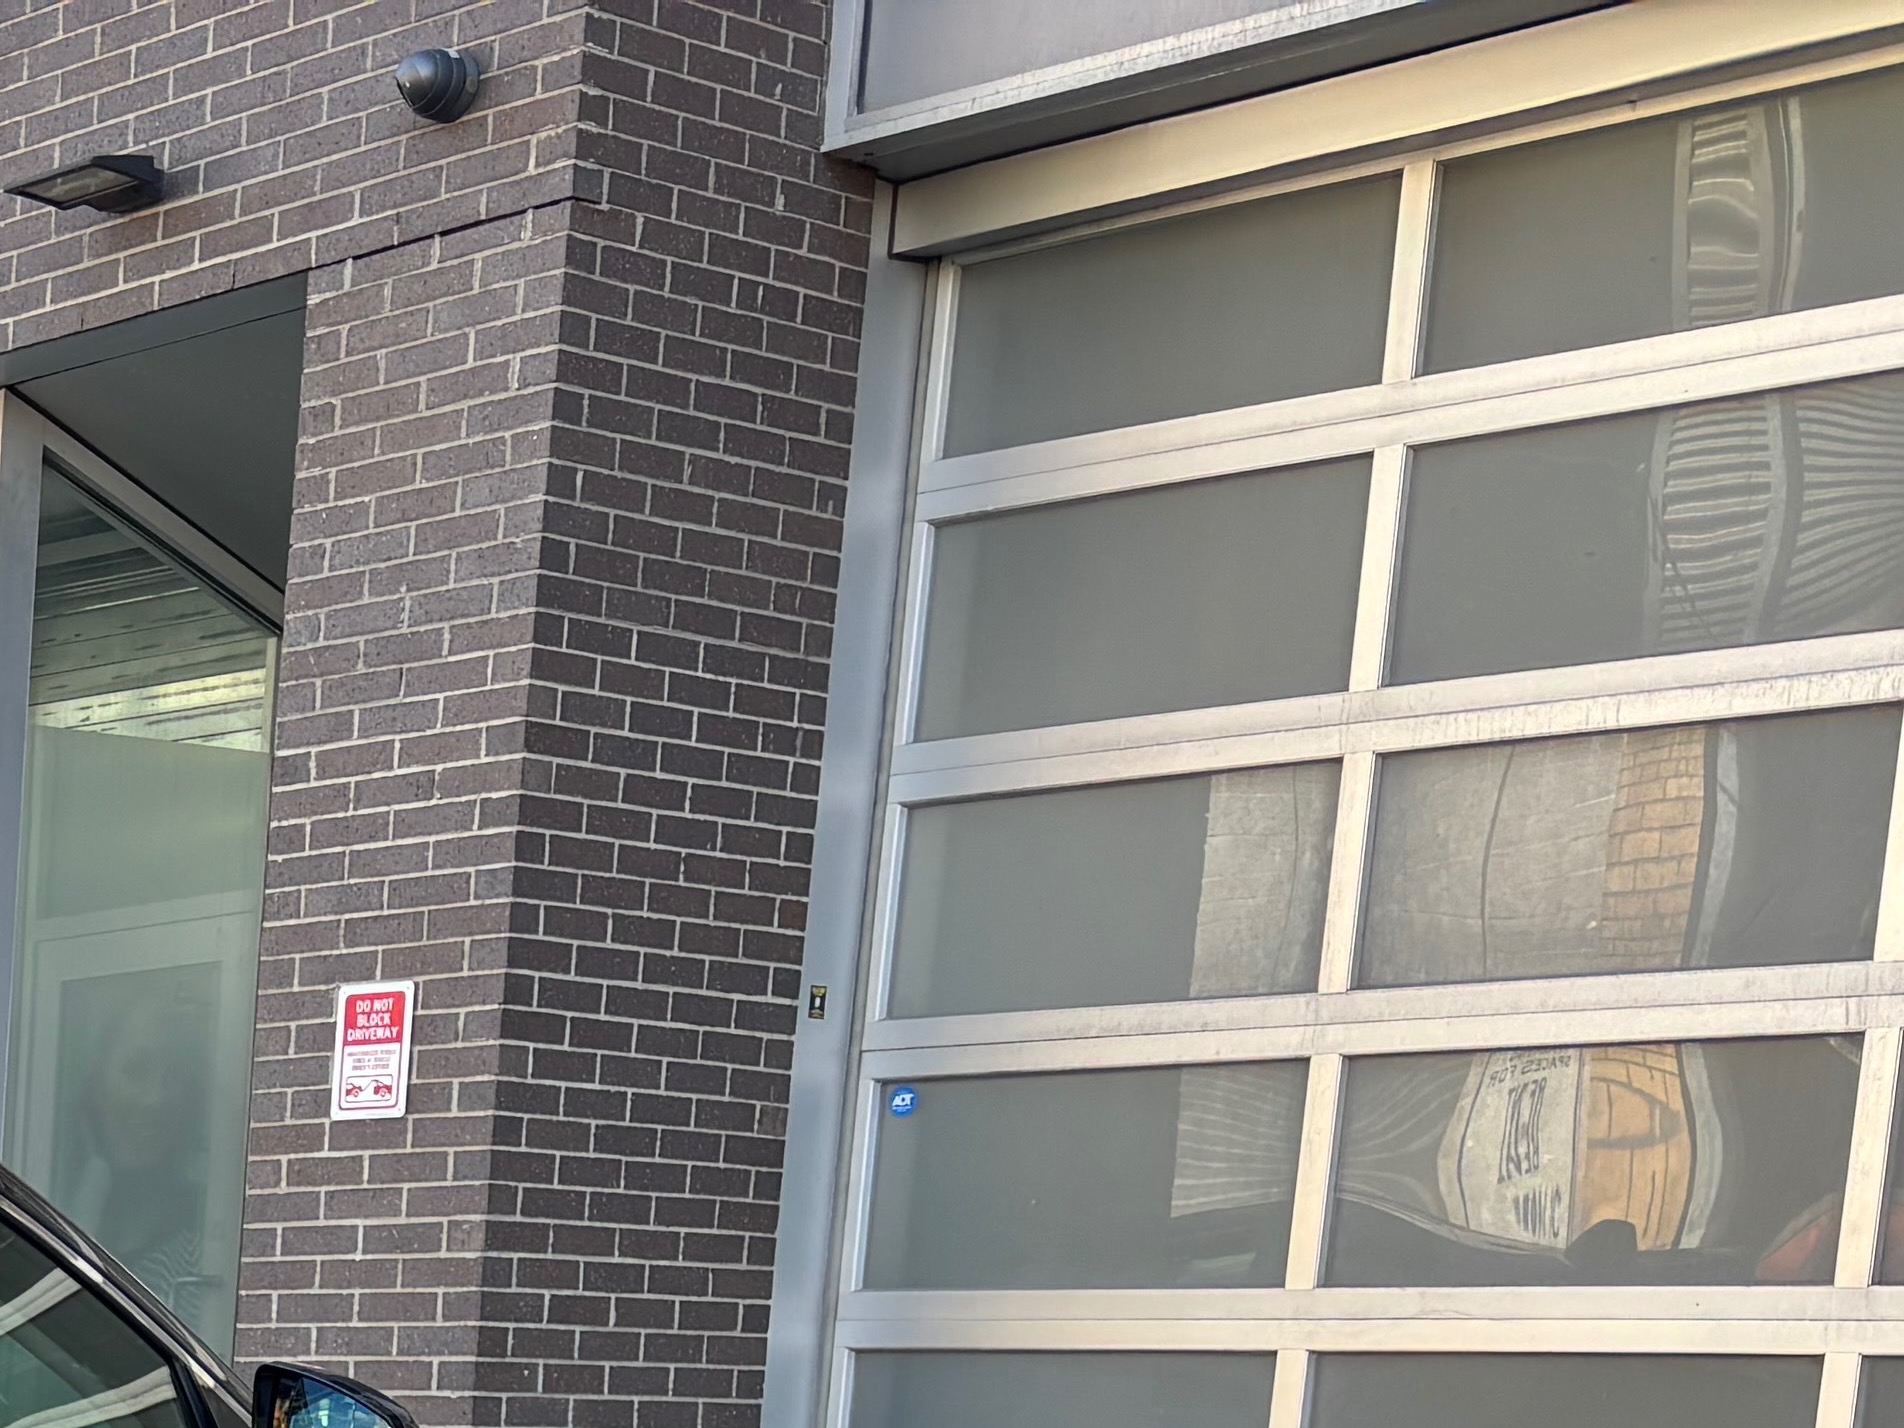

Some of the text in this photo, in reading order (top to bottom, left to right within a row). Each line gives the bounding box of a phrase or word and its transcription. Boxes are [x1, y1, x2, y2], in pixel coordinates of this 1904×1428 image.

[356, 997, 394, 1013] DO NOT
[357, 1012, 391, 1027] BLOCK
[347, 1026, 399, 1042] DRIVEWAY
[892, 1093, 914, 1106] ADT
